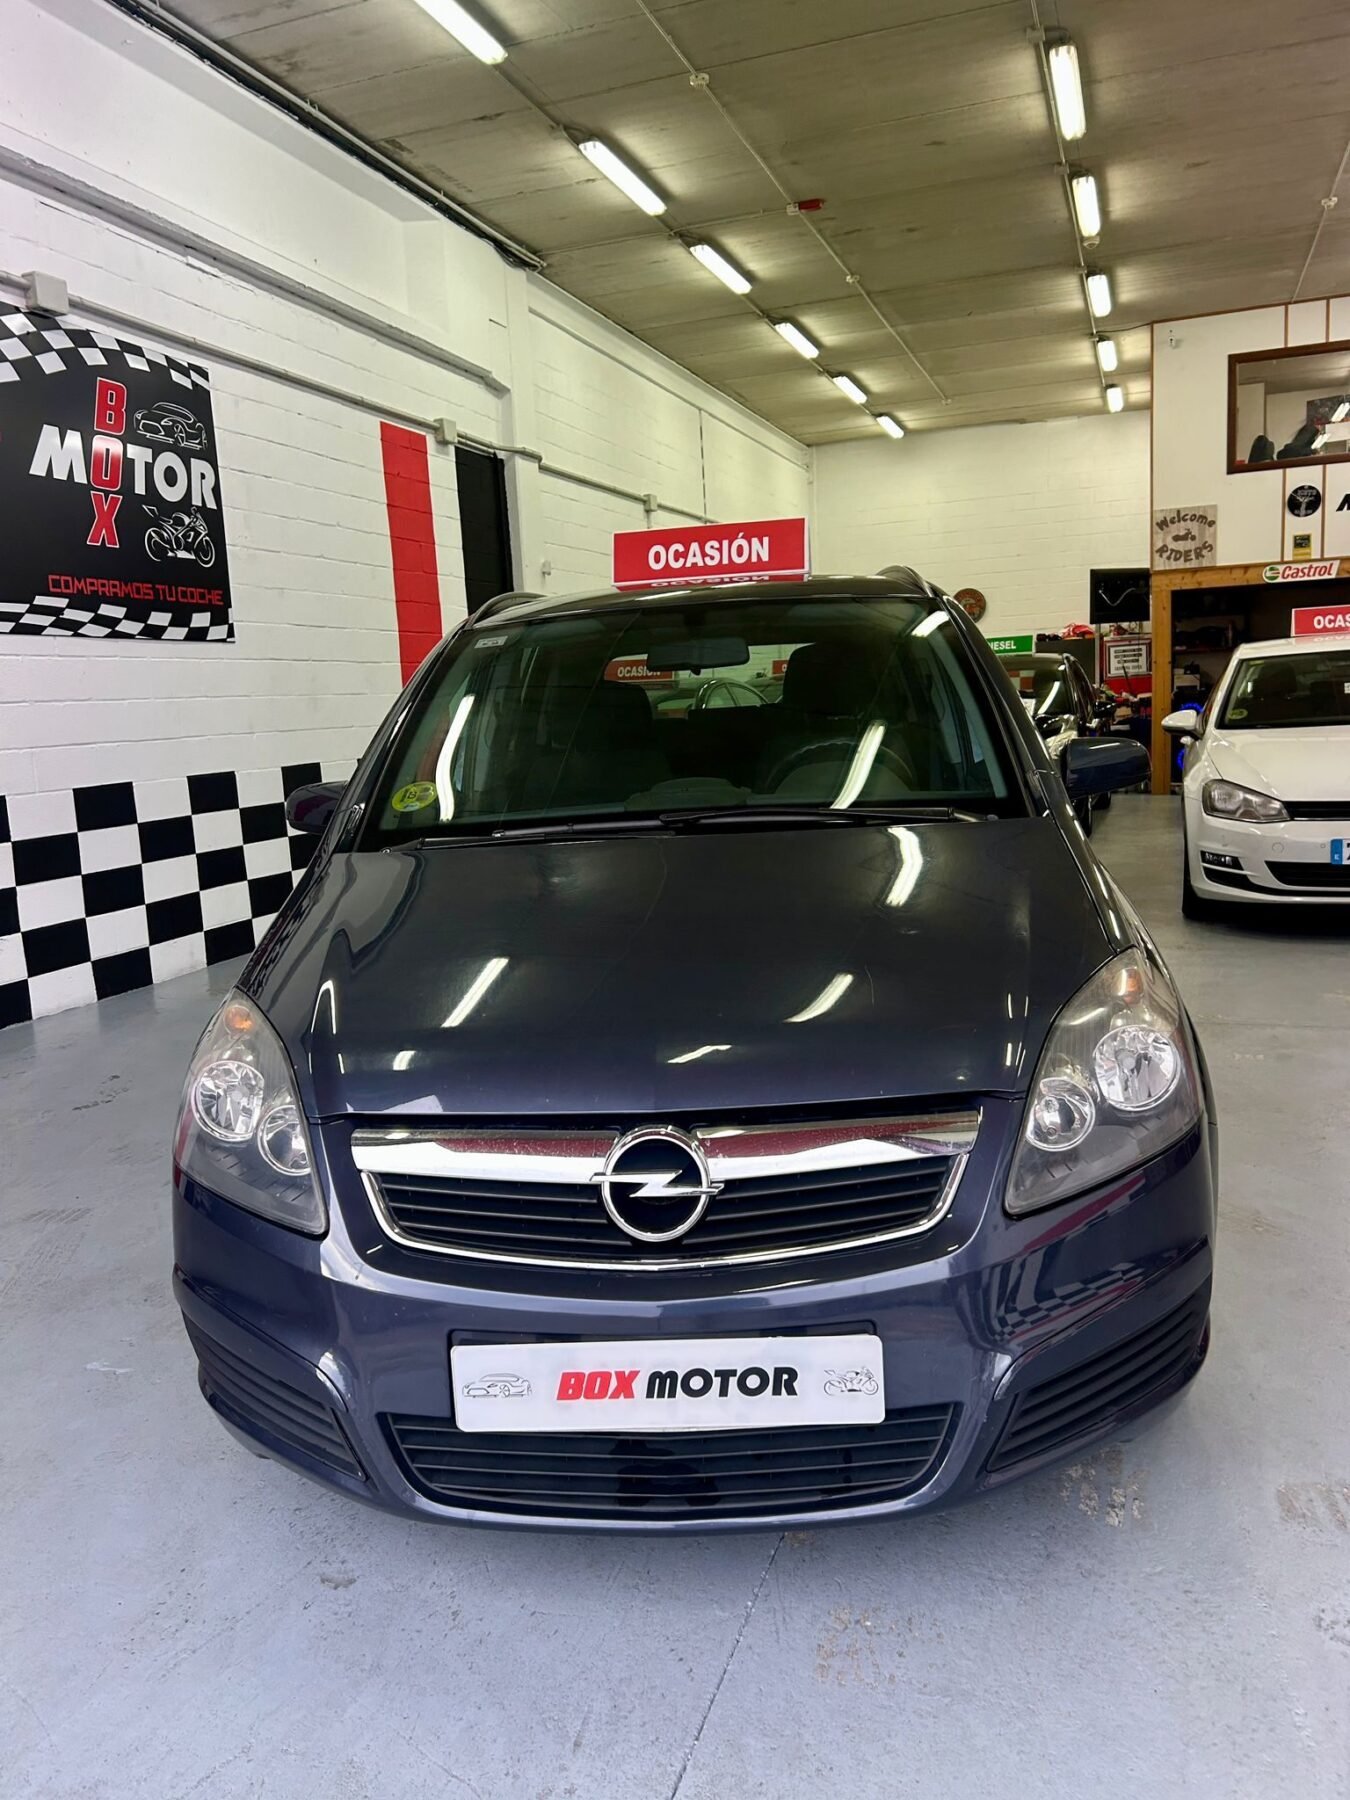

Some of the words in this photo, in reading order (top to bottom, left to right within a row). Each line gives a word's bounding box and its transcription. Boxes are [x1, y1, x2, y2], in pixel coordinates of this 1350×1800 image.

[29, 424, 218, 509] MOTOR
[86, 376, 127, 549] BOX
[1155, 509, 1216, 531] Welcome
[648, 532, 769, 570] OCASIÓN
[1155, 540, 1214, 563] RIDERS
[1281, 562, 1334, 580] Castrol
[48, 574, 153, 600] COMPRAMOS
[155, 584, 176, 601] TU
[177, 586, 224, 605] COCHE
[557, 1370, 640, 1400] BOX
[646, 1367, 798, 1399] MOTOR
